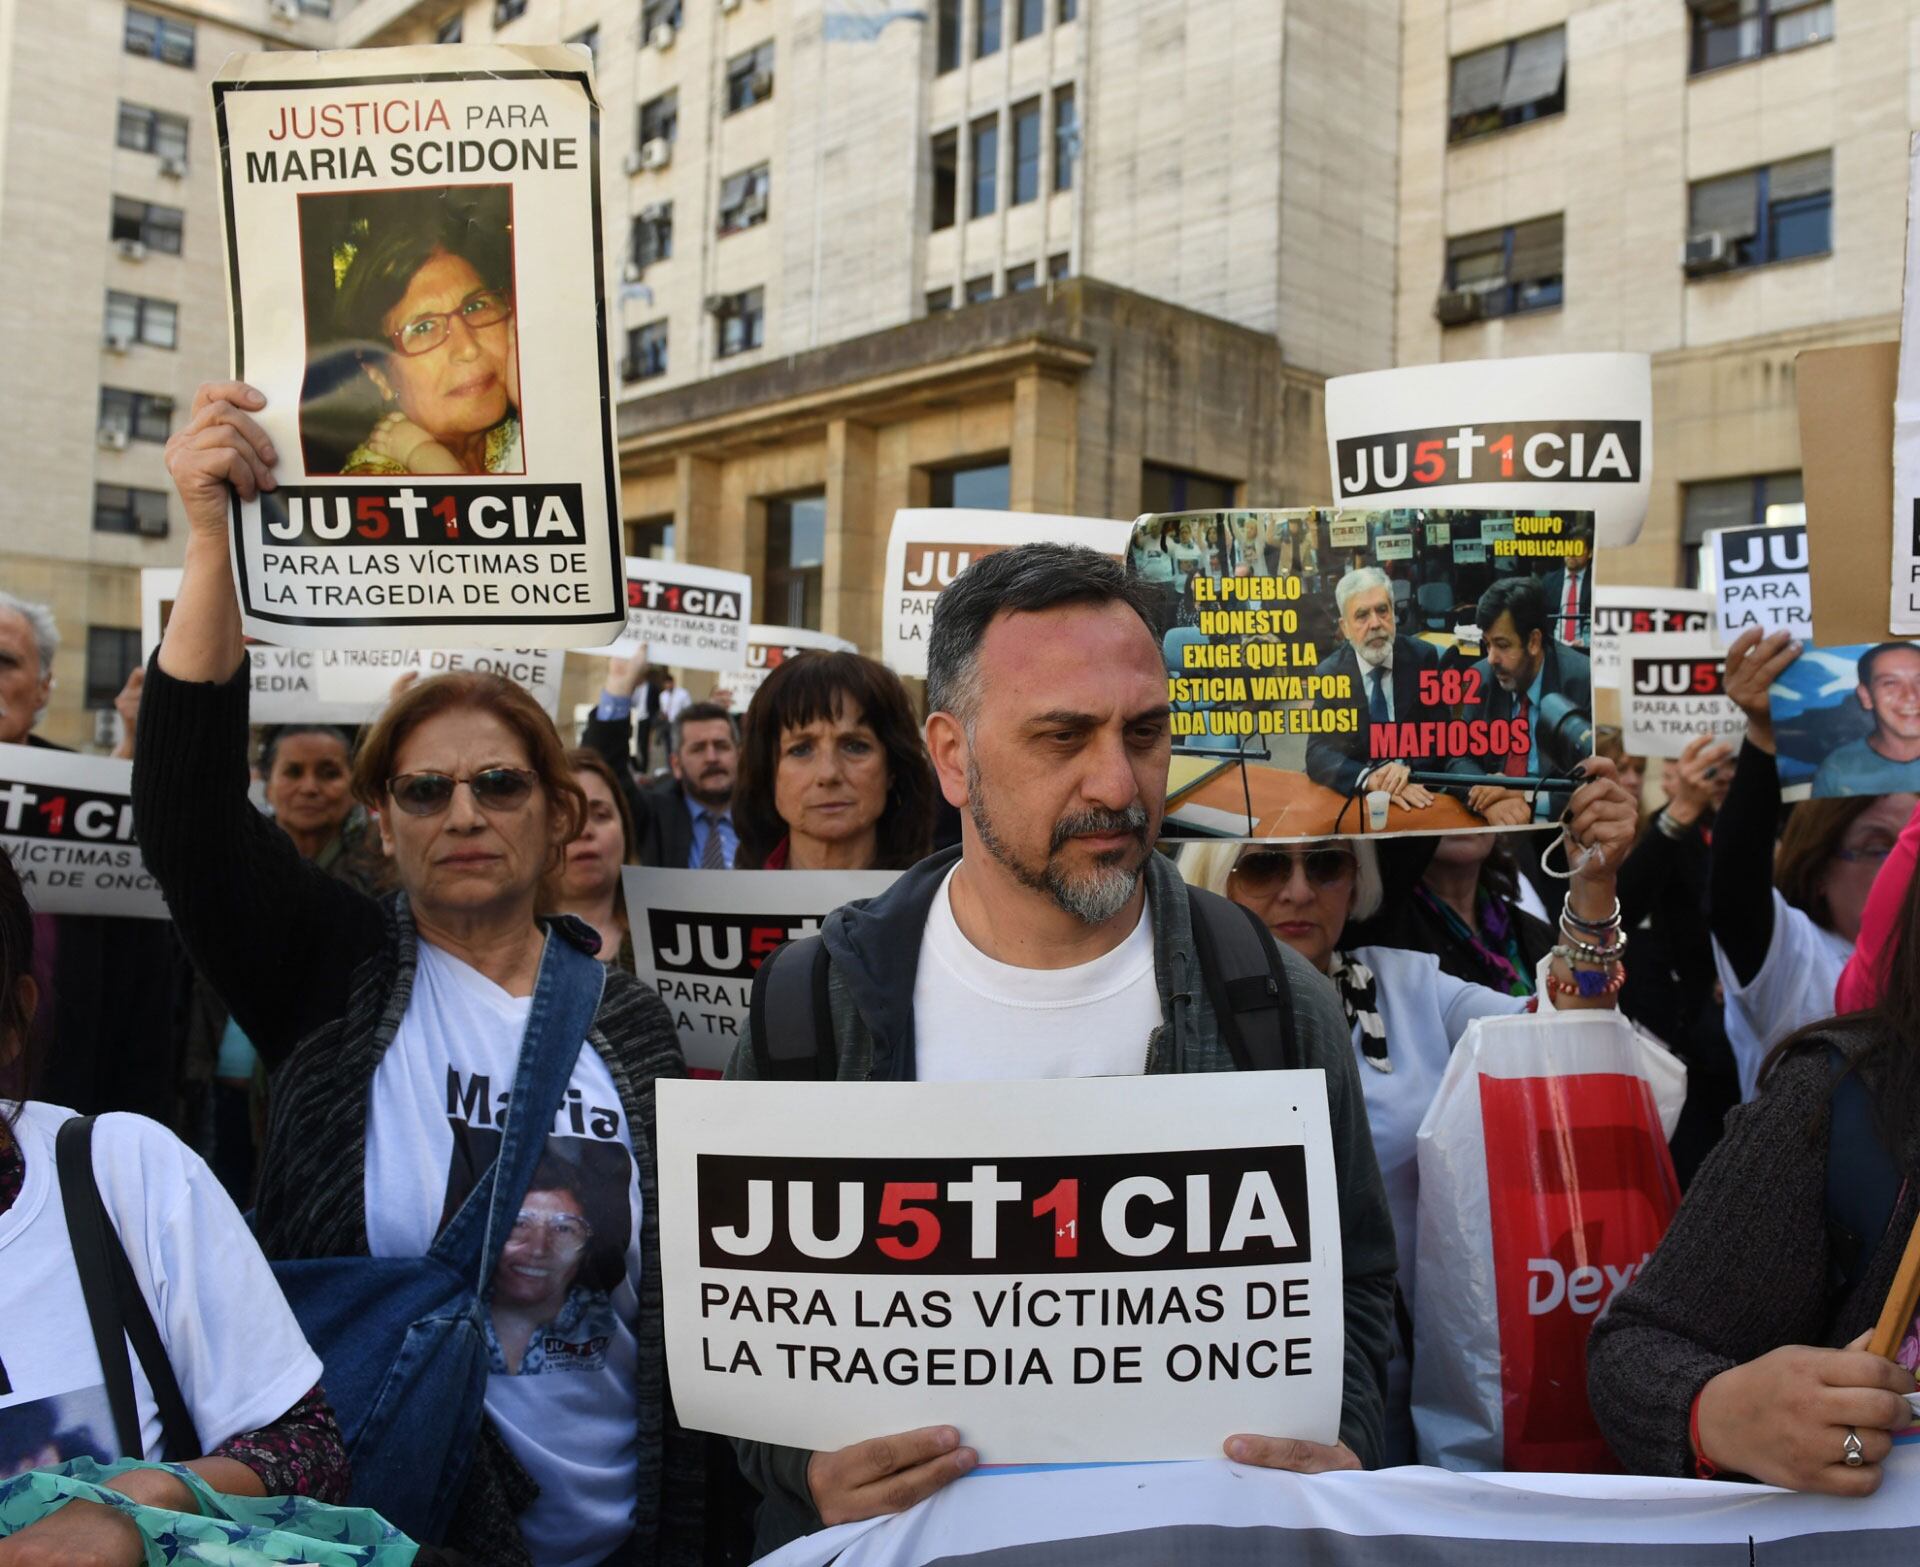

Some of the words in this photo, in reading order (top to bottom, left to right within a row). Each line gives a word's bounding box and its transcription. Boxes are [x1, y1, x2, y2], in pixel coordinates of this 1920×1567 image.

[269, 98, 451, 141] JUSTICIA
[466, 104, 549, 129] PARA
[246, 145, 378, 183] MARIA
[390, 137, 578, 176] SCIDONE
[1513, 517, 1562, 534] EQUIPO
[1494, 539, 1584, 557] REPUBLICANO
[263, 554, 339, 575] PARA
[349, 555, 400, 574] LAS
[409, 549, 539, 574] VÍCTIMAS
[550, 554, 587, 573] DE
[264, 583, 298, 605] LA
[306, 585, 454, 606] TRAGEDIA
[464, 584, 500, 604] DE
[511, 584, 591, 604] ONCE
[1195, 577, 1217, 600] EL
[1221, 576, 1301, 600] PUEBLO
[1725, 582, 1800, 602] PARA
[899, 624, 921, 640] LA
[1200, 610, 1298, 634] HONESTO
[1726, 613, 1758, 629] LA
[430, 652, 463, 670] DE
[1183, 645, 1242, 668] EXIGE
[1246, 644, 1288, 669] QUE
[1292, 643, 1318, 666] LA
[1250, 676, 1304, 701] VAYA
[1307, 675, 1352, 699] POR
[1419, 668, 1482, 705] 582
[1633, 702, 1679, 714] PARA
[1686, 703, 1719, 714] LAS
[1211, 711, 1254, 734] UNO
[1258, 710, 1285, 733] DE
[1290, 708, 1359, 733] ELLOS!
[1369, 718, 1530, 758] MAFIOSOS
[48, 870, 85, 888] DE
[657, 978, 732, 1006] PARA
[701, 1283, 837, 1327] PARA
[854, 1291, 953, 1328] LAS
[973, 1282, 1224, 1327] VÍCTIMAS
[1246, 1279, 1311, 1320] DE
[702, 1337, 762, 1376] LA
[777, 1344, 1053, 1386] TRAGEDIA
[1073, 1347, 1142, 1383] DE
[1165, 1338, 1312, 1382] ONCE
